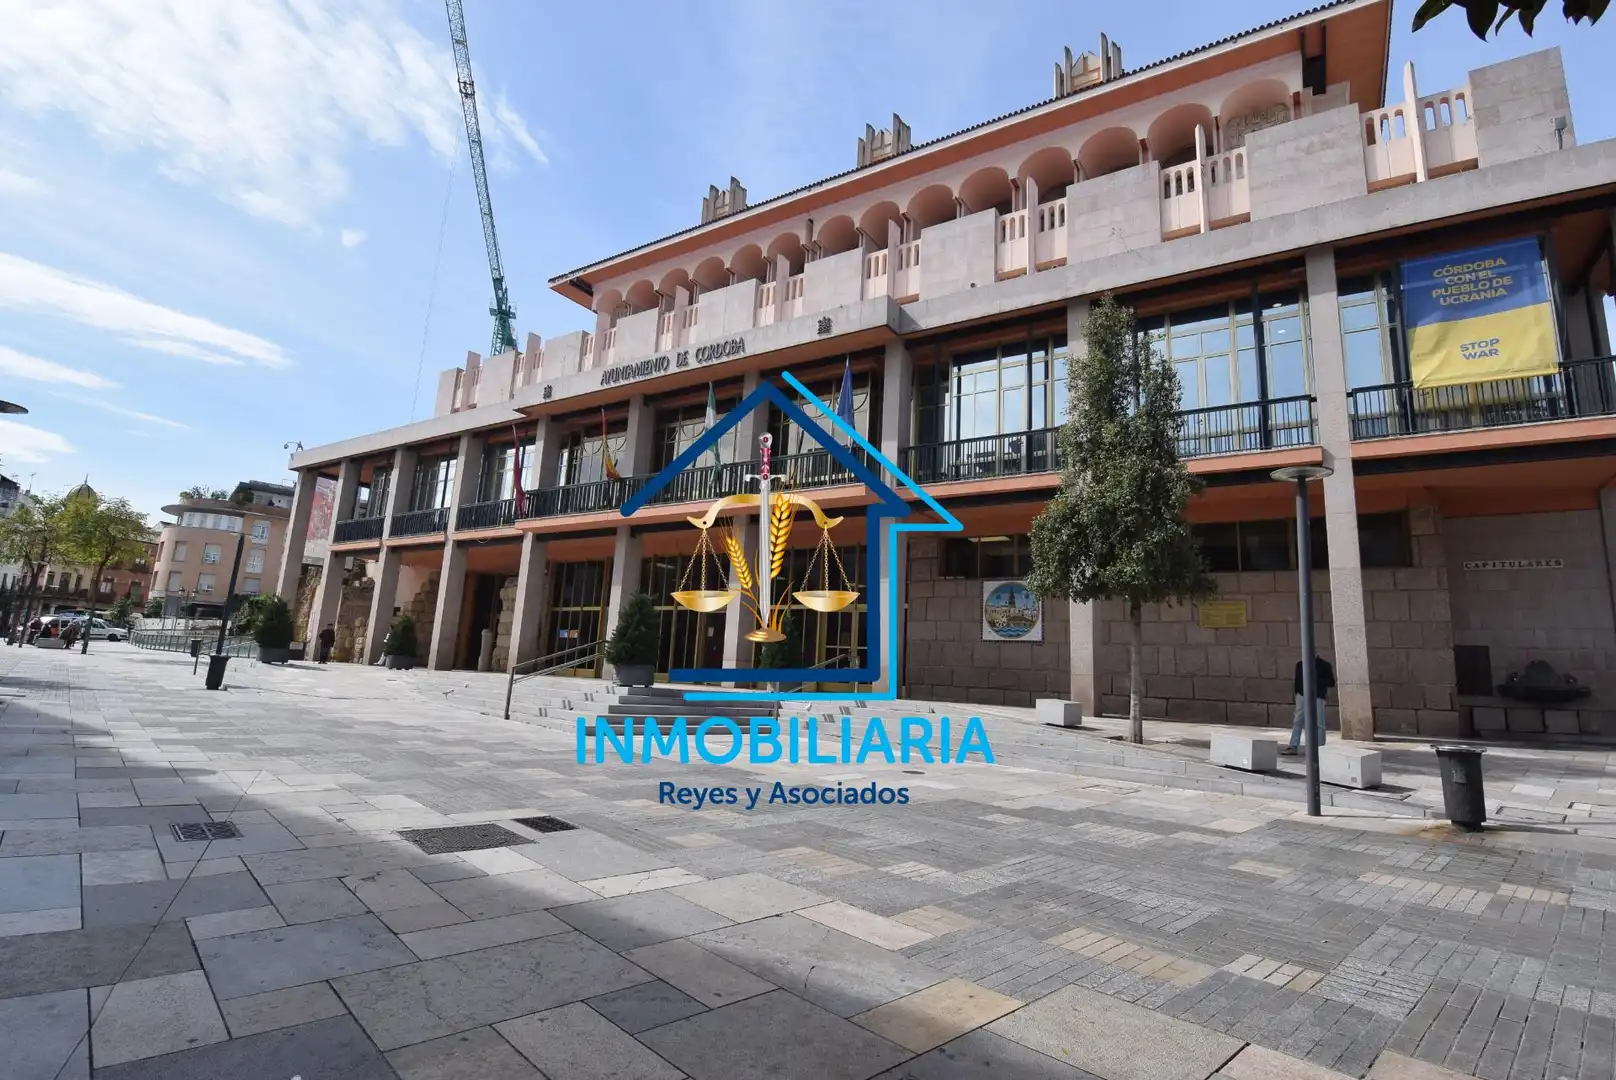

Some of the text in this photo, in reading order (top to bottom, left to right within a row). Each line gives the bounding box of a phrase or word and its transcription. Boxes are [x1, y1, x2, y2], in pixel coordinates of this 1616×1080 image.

[1433, 257, 1507, 278] CÓRDOBA
[1445, 270, 1497, 285] CON EL
[1432, 275, 1513, 298] PUEBLO DE
[1440, 287, 1508, 305] UCRANIA
[1459, 338, 1500, 353] STOP
[600, 337, 746, 386] AYUNTAMIENTO DE CORDOBA
[1462, 348, 1499, 361] WAR
[1464, 560, 1562, 570] CAPITULARES
